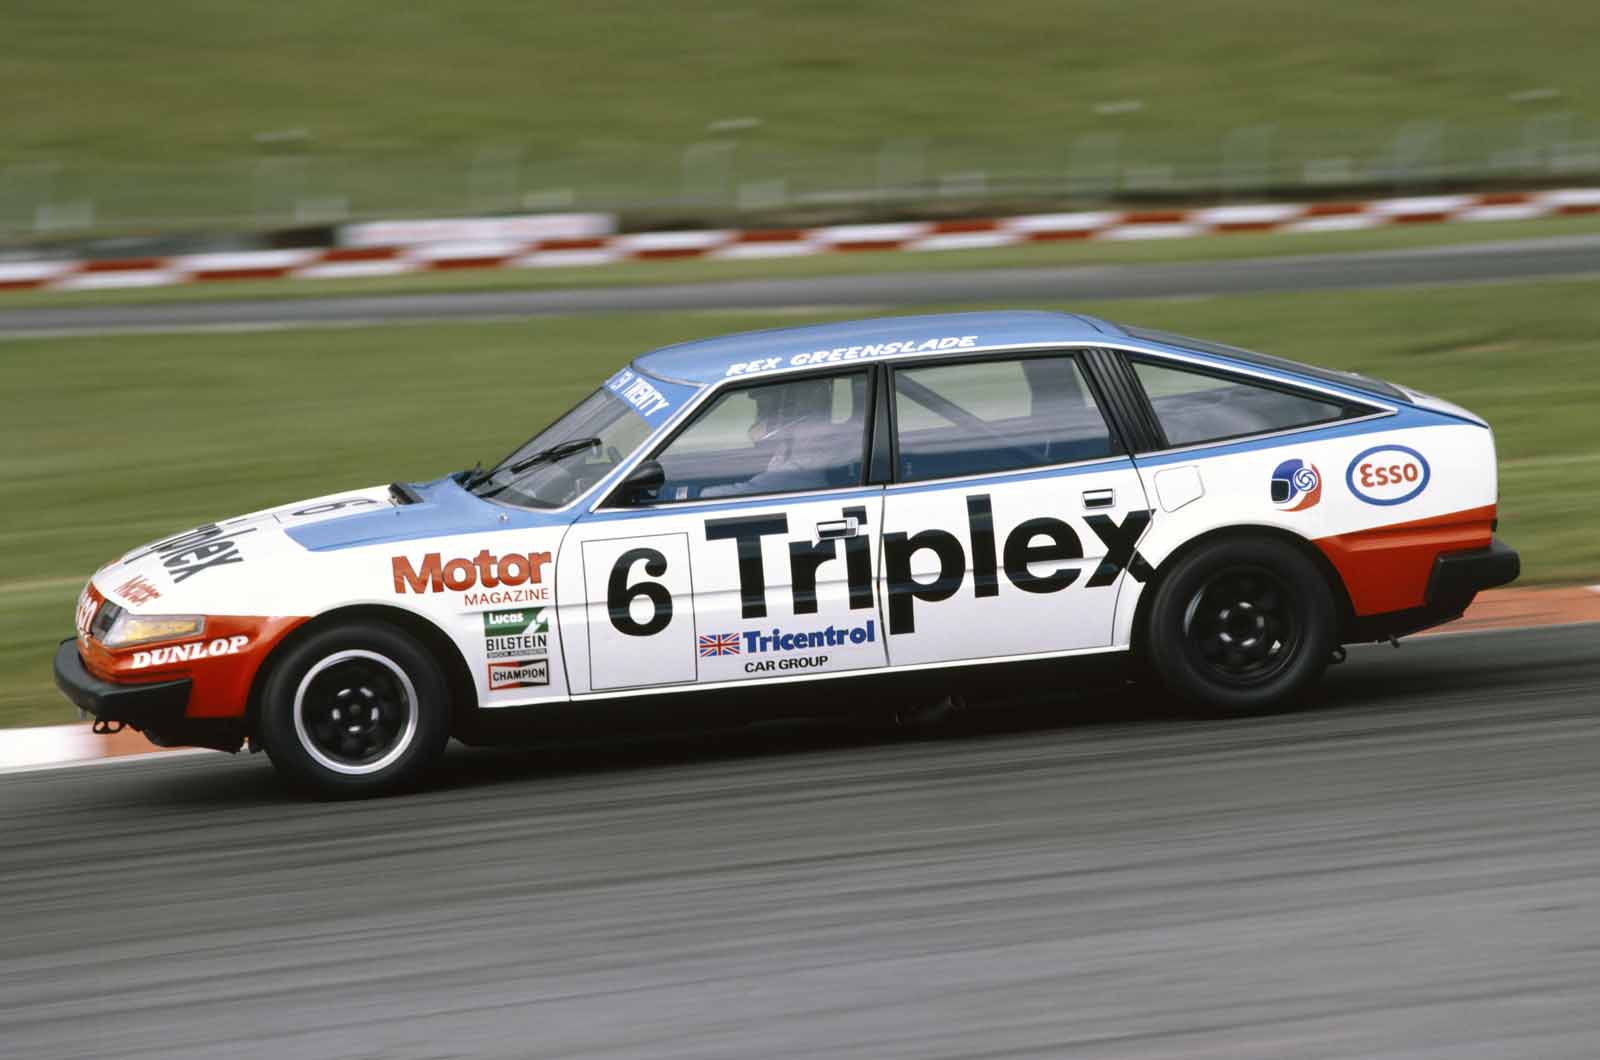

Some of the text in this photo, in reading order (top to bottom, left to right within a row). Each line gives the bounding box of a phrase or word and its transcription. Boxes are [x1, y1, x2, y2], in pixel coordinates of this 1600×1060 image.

[726, 336, 978, 376] REX GREENSLADE
[391, 549, 552, 593] Motor
[704, 493, 1157, 635] Triplex
[464, 587, 549, 607] MAGAZINE
[607, 547, 673, 637] 6
[489, 613, 524, 625] Lucas
[131, 635, 249, 669] DUNLOP
[486, 635, 547, 651] BILSTEIN
[743, 620, 875, 653] Tricentrol
[493, 668, 545, 681] CHAMPION
[744, 656, 828, 673] CAR GROUP
